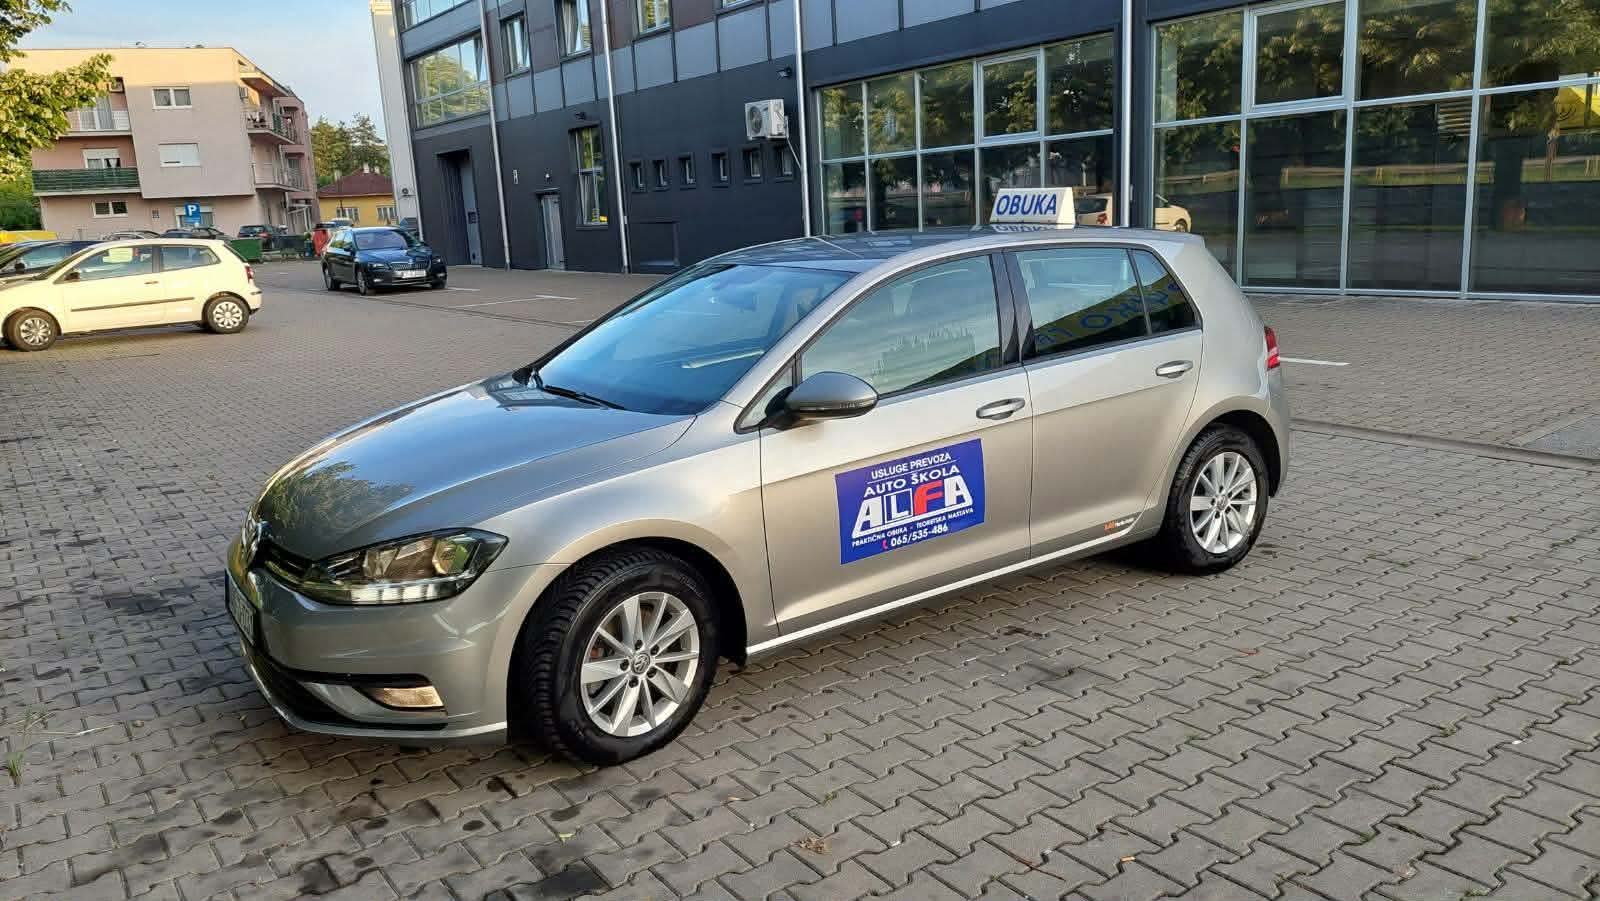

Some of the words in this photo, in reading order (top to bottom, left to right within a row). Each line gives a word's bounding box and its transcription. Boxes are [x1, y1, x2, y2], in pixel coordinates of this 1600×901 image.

[187, 204, 198, 216] P
[996, 193, 1057, 215] OBUKA
[871, 462, 908, 480] USLUGE
[910, 452, 951, 470] PREVOZA
[863, 478, 906, 498] AUTO
[911, 464, 960, 485] ŠKOLA
[852, 475, 973, 539] ALFA
[886, 526, 908, 538] OBUKA
[890, 521, 949, 547] 065/535-486
